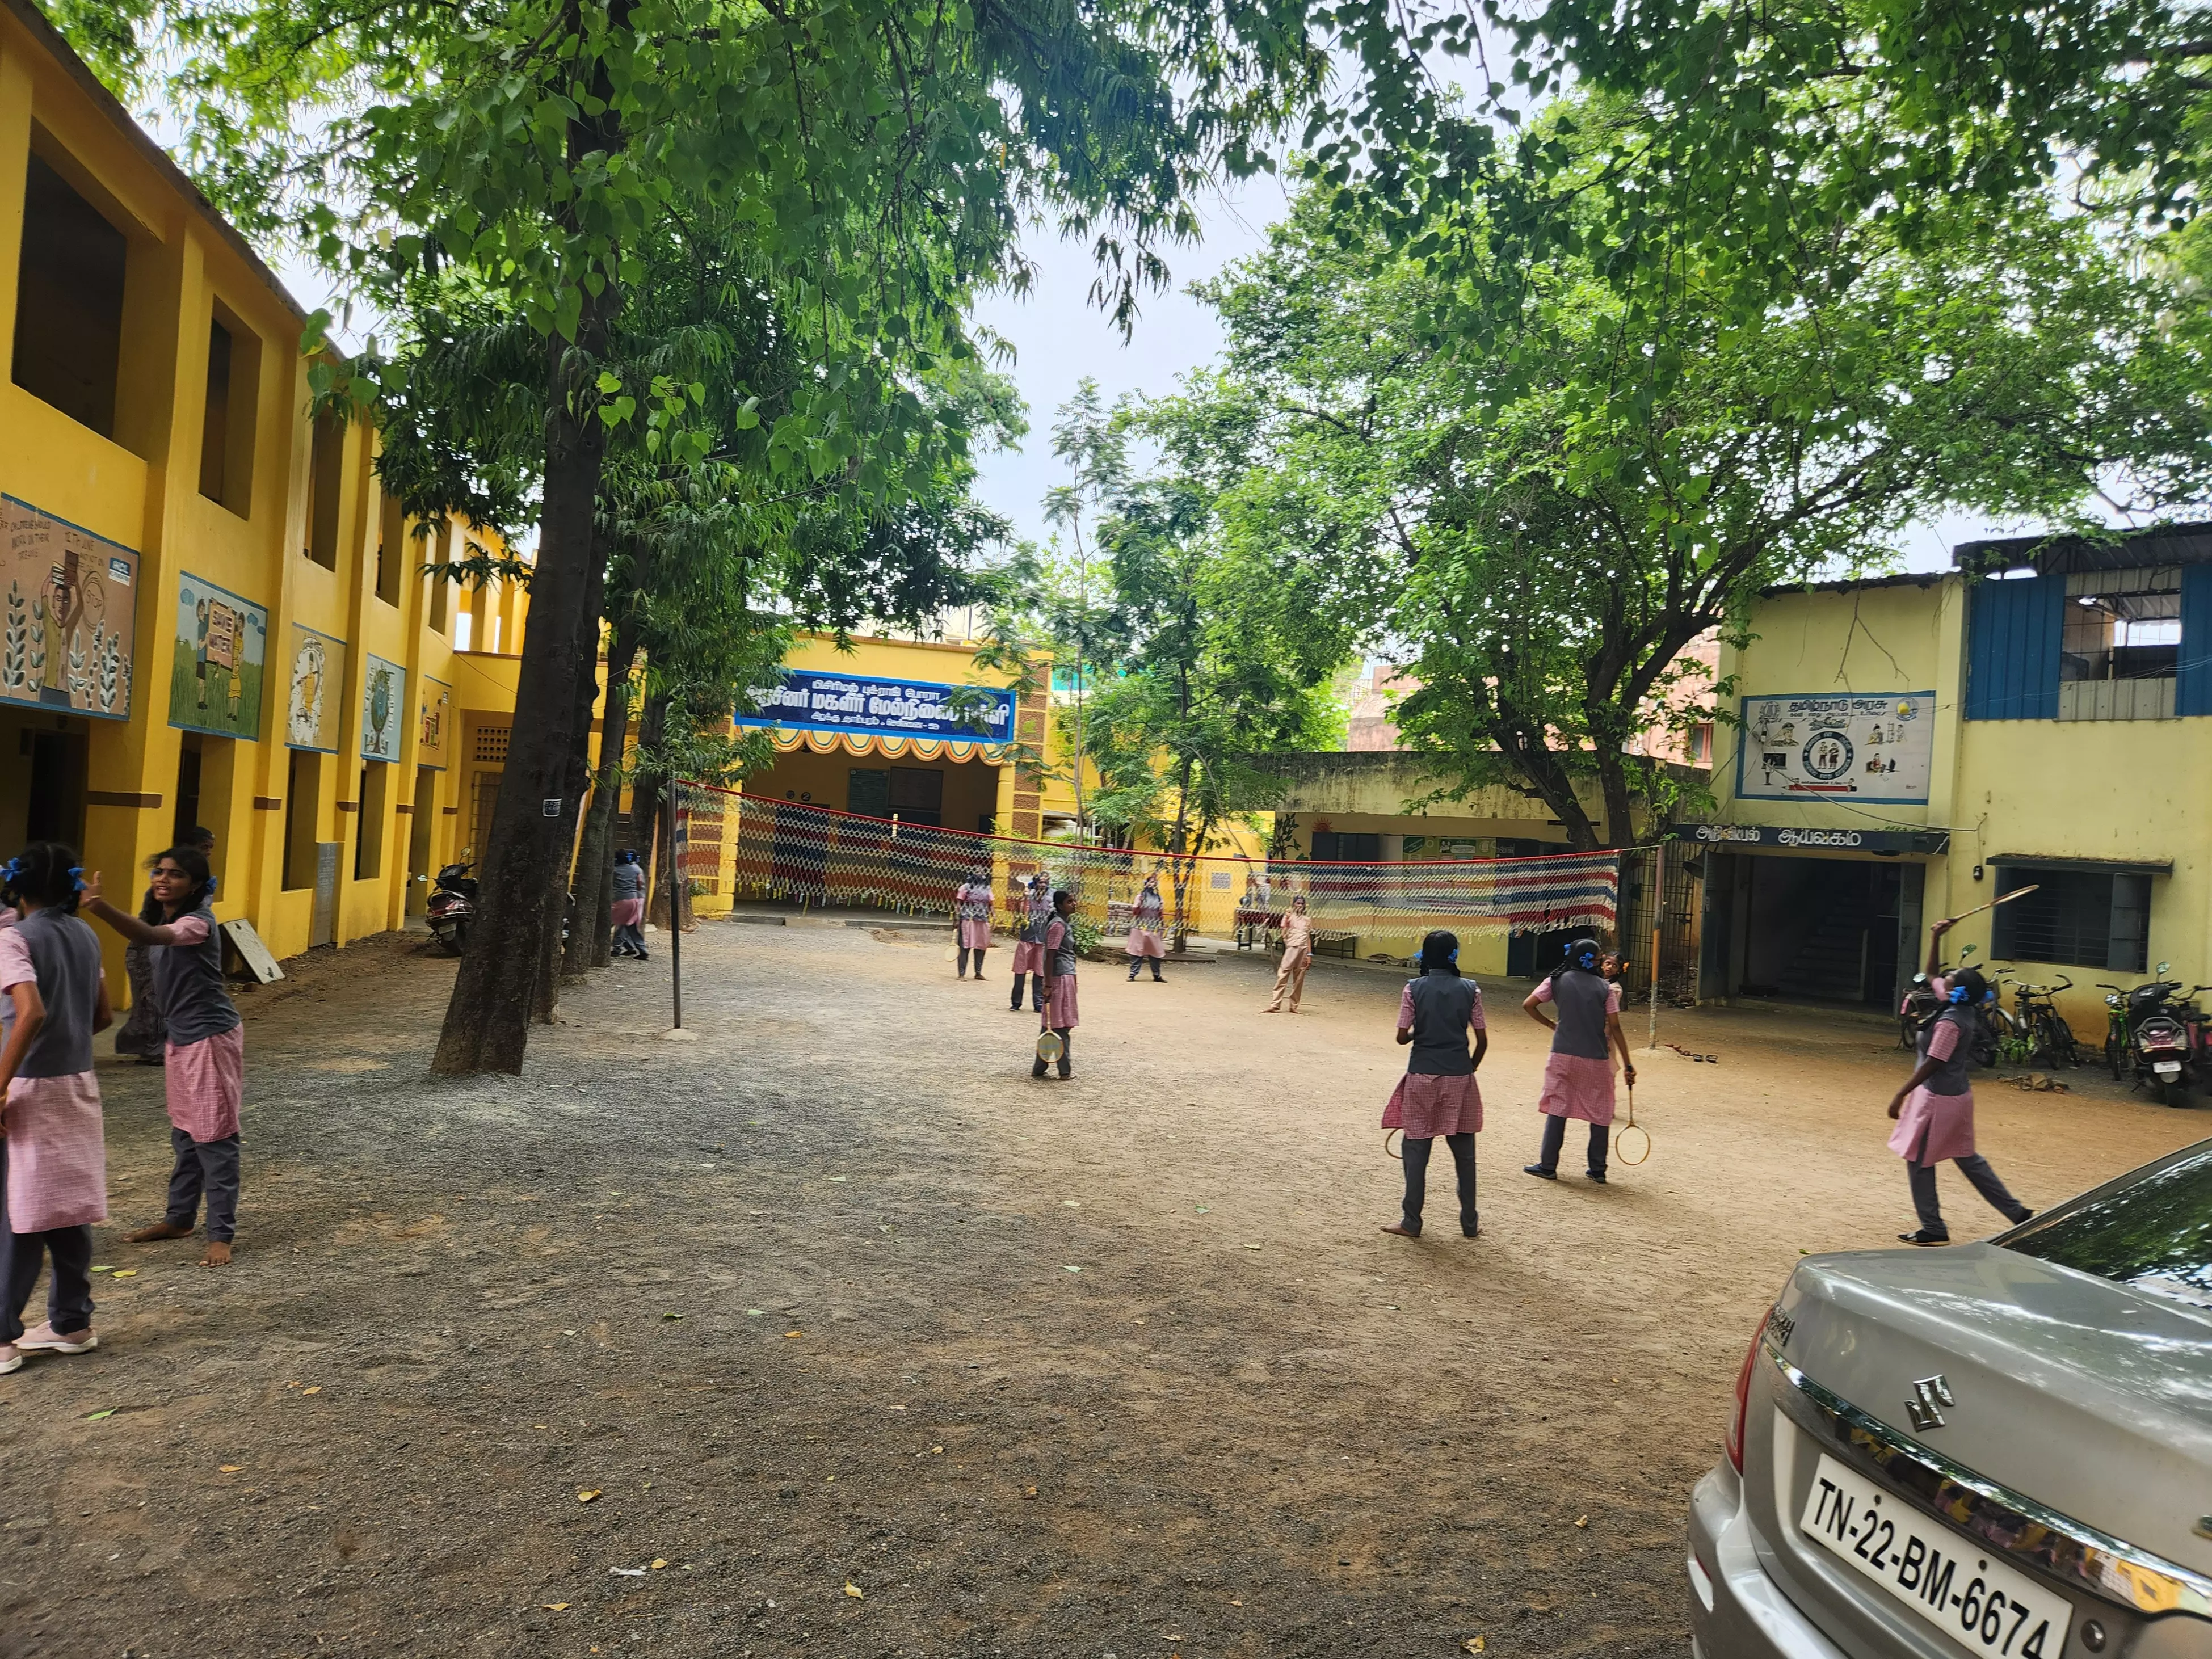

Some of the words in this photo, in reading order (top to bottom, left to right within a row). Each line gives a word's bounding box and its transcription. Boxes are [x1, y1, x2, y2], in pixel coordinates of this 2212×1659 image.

[811, 692, 865, 713] மகளிர்
[1788, 699, 1848, 711] தமிழ்நாடு
[1852, 699, 1888, 710] அரசு
[1778, 828, 1862, 846] ஆய்வகம்
[1814, 1477, 2050, 1659] TN-22-BM-6674
